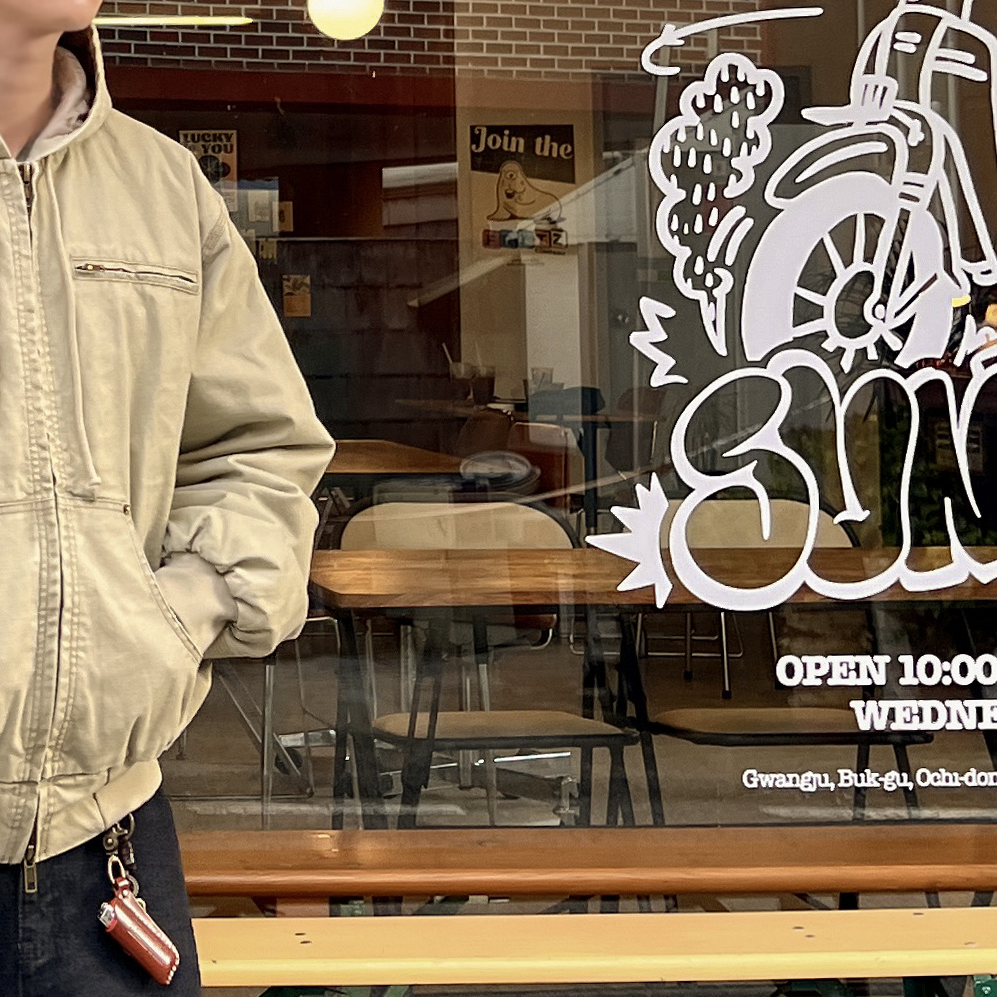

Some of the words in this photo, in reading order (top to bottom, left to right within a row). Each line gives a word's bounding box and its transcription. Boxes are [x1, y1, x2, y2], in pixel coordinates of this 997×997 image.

[183, 132, 234, 143] LUCKY
[201, 143, 234, 154] YOU
[471, 126, 524, 153] Join
[535, 135, 573, 159] the
[775, 654, 891, 687] OPEN
[898, 653, 997, 687] 10:00
[849, 699, 997, 731] WEDNE
[837, 768, 914, 791] Buk-gu,
